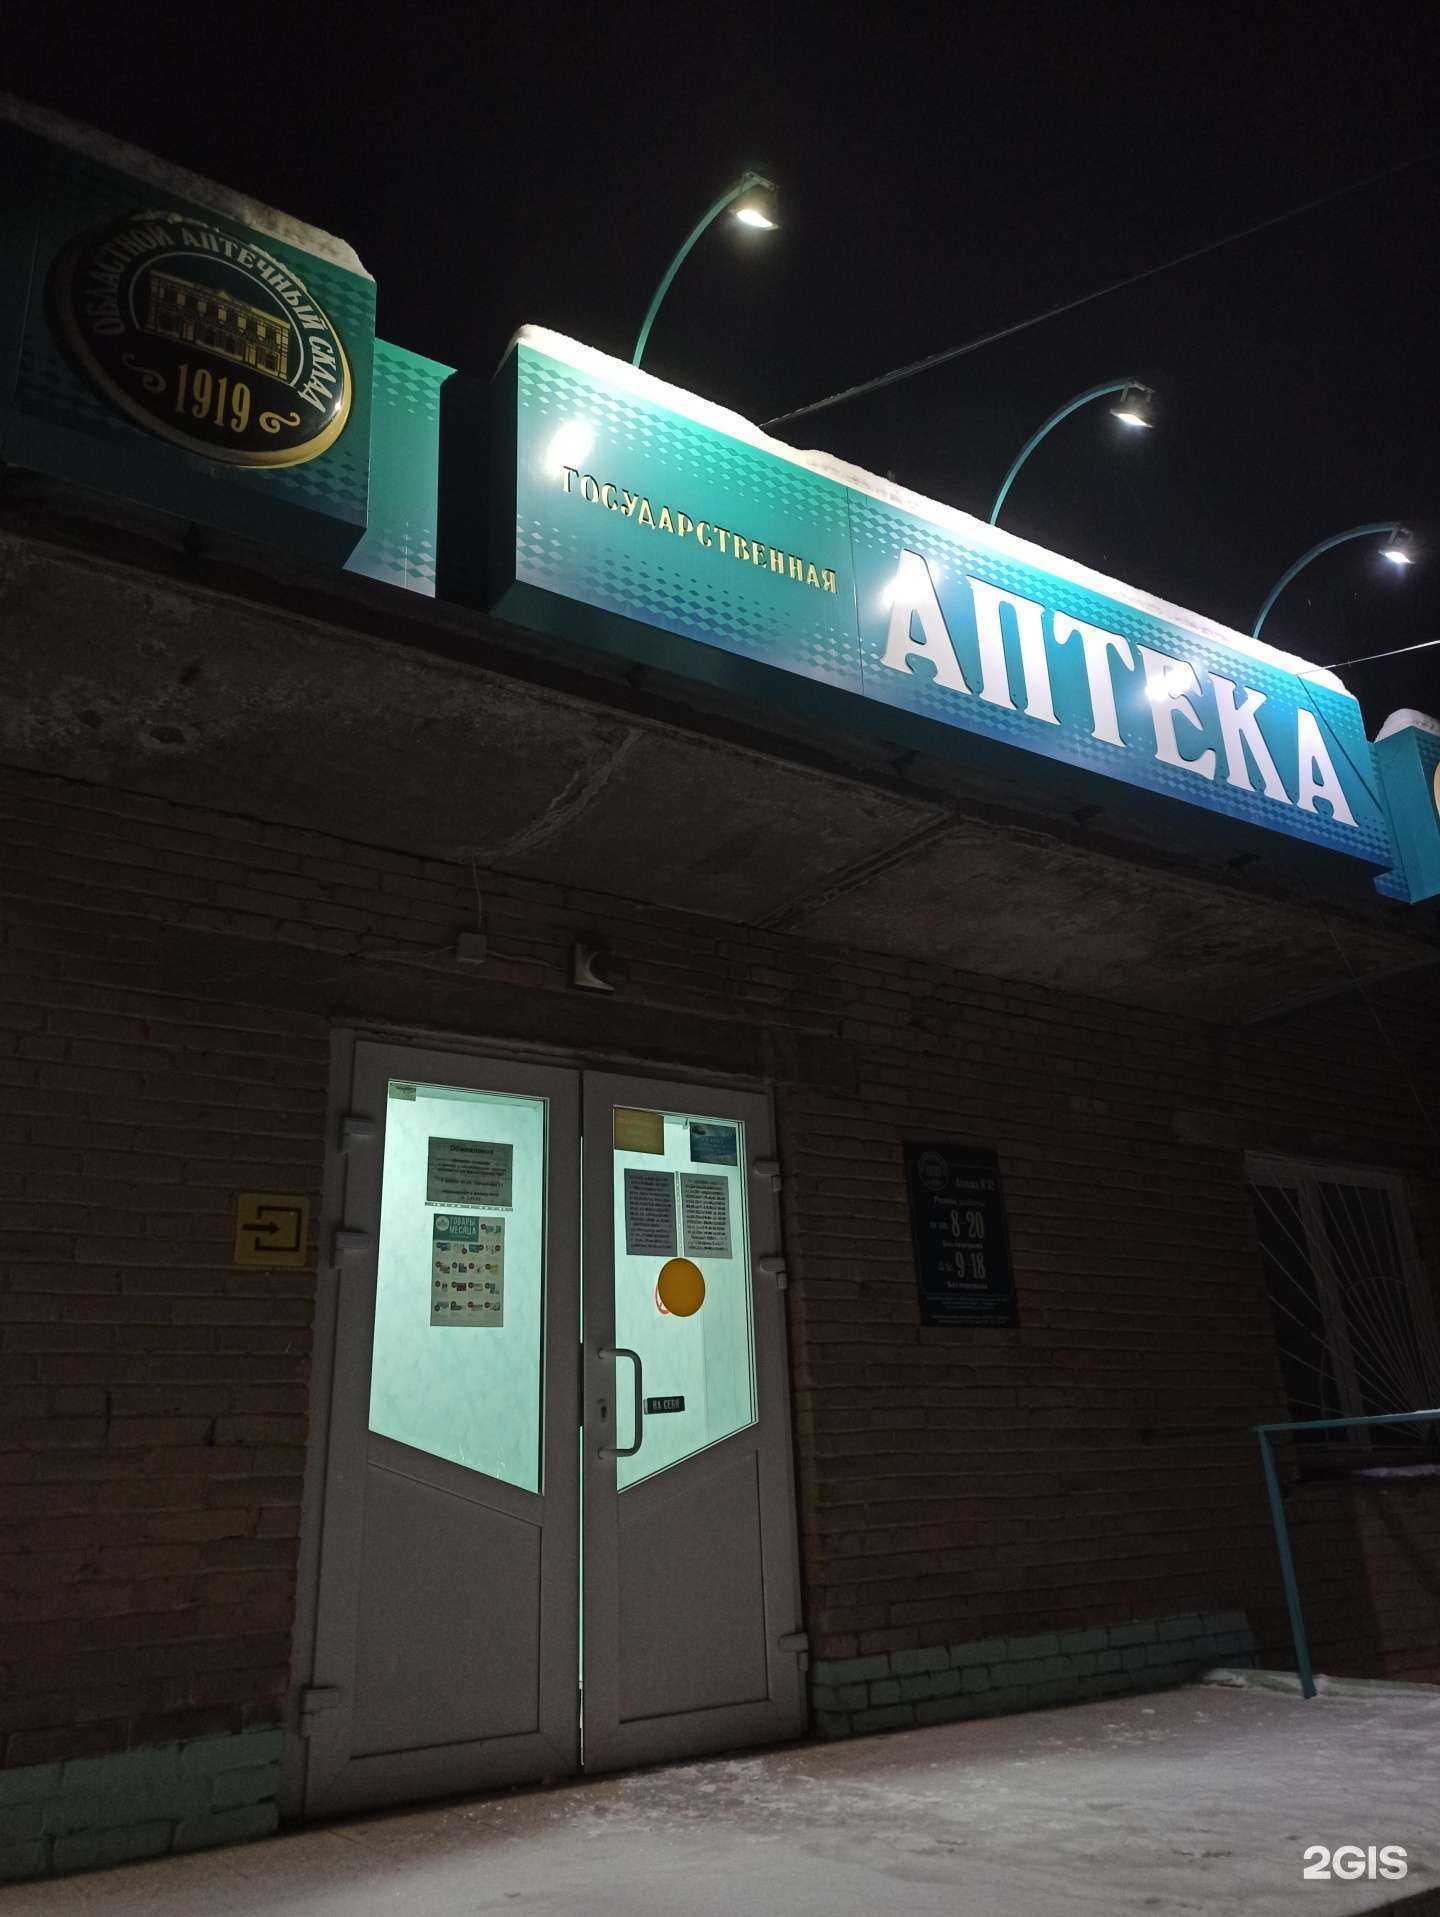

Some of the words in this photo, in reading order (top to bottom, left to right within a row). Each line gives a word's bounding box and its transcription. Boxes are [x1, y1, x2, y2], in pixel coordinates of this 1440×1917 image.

[82, 223, 175, 336] ОБЛАСТНОЙ
[181, 226, 328, 332] АПТЕЧНЫЙ
[296, 334, 338, 414] СКЛАД
[175, 362, 253, 434] 1919
[560, 464, 838, 594] ГОСУДАРСТВЕННАЯ
[881, 549, 1359, 828] АПТЕКА
